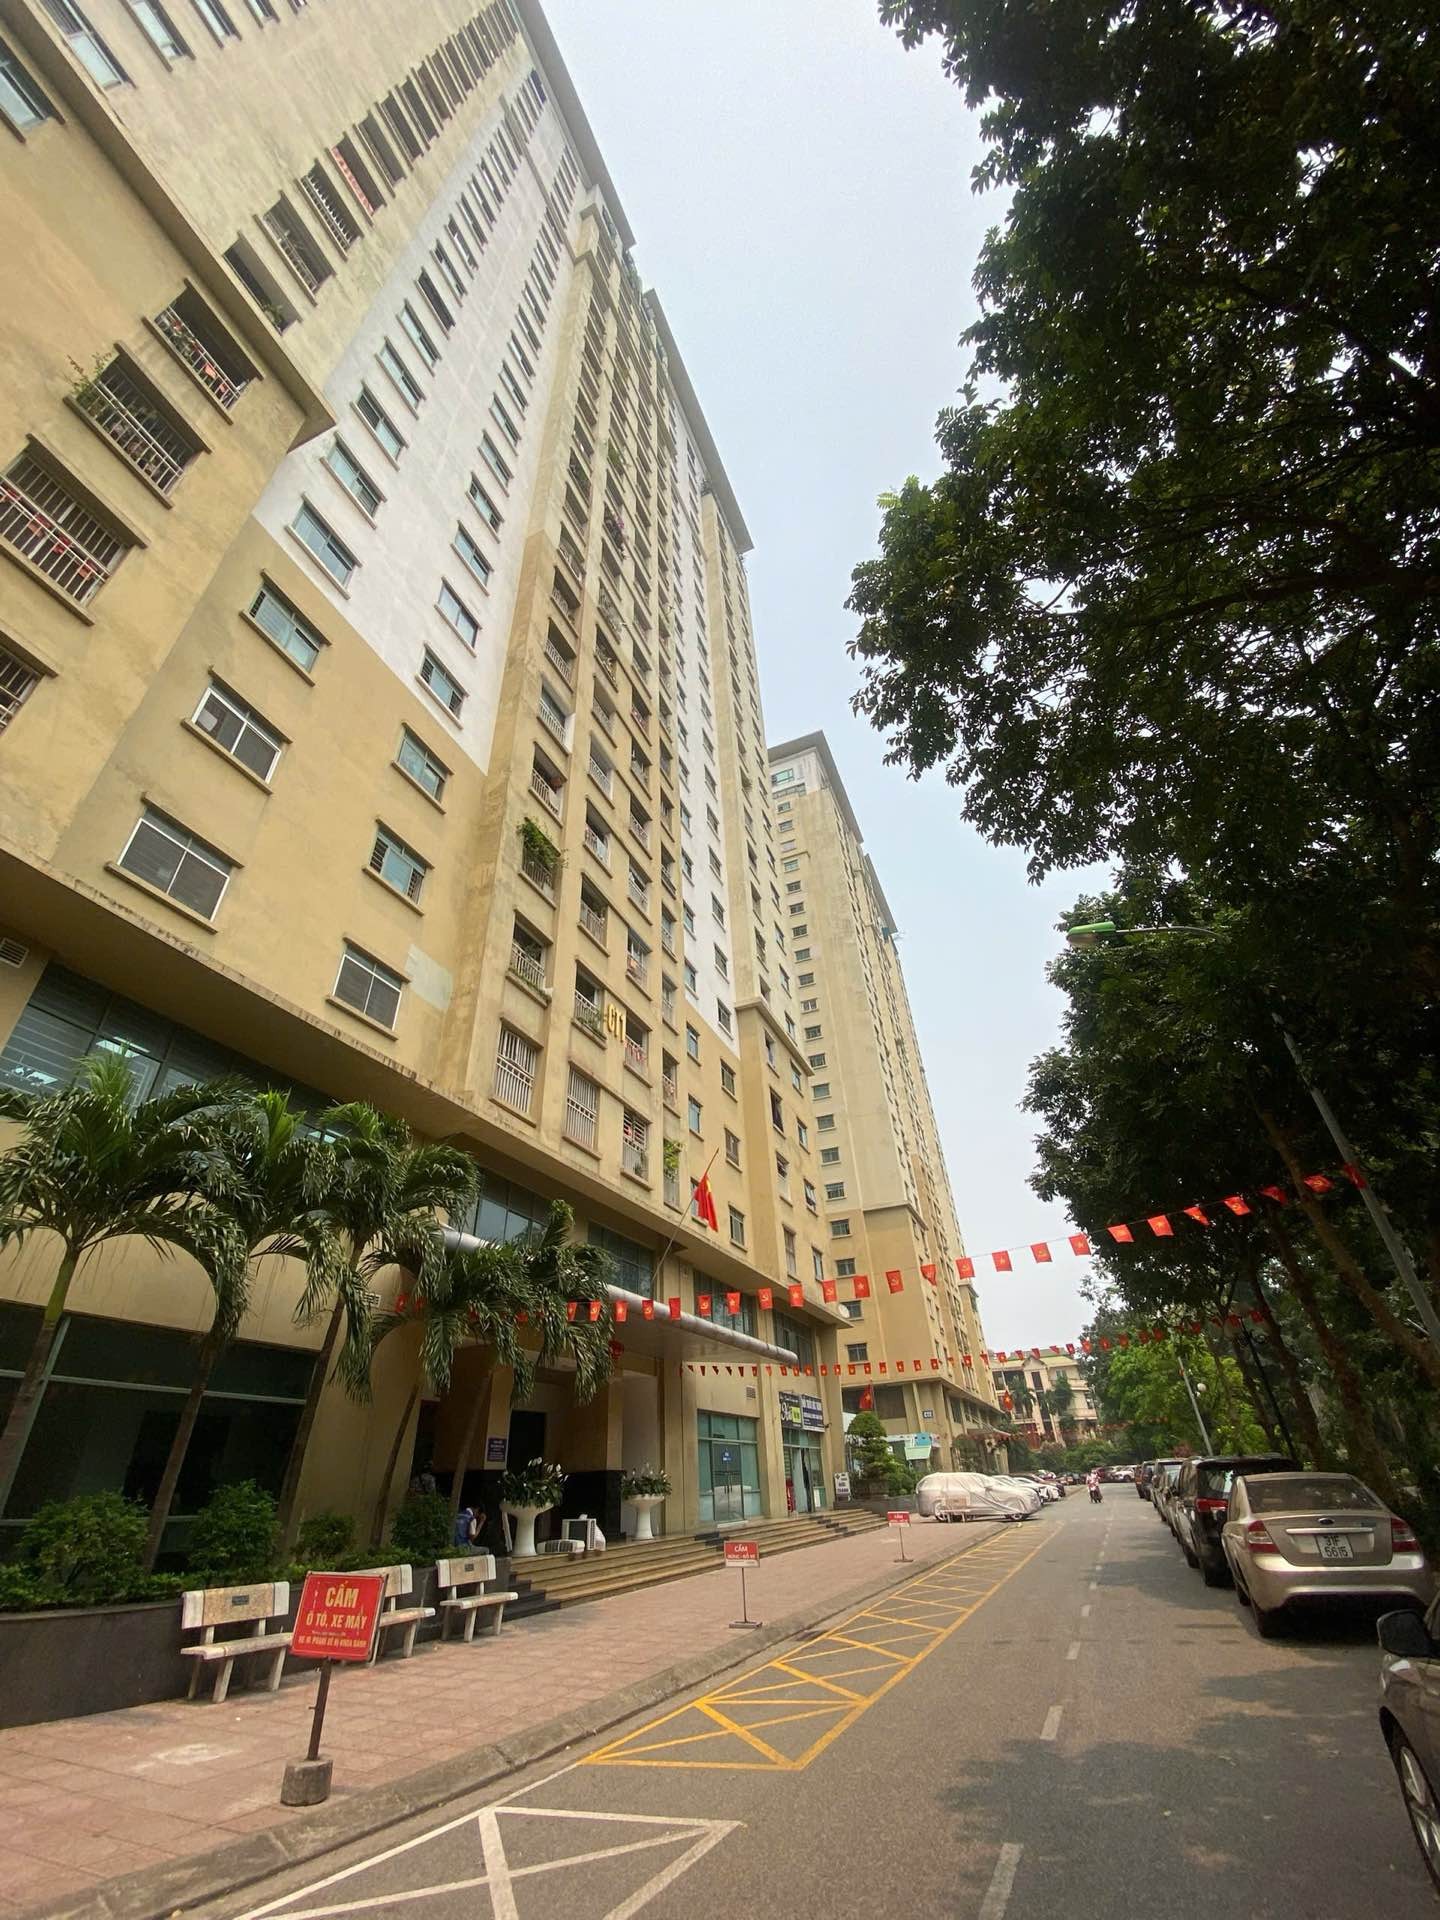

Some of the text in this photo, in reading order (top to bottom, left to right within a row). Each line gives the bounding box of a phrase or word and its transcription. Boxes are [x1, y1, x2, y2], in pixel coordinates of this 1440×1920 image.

[608, 1003, 626, 1042] CT1
[324, 1581, 359, 1608] CẤM
[330, 1614, 345, 1628] XE
